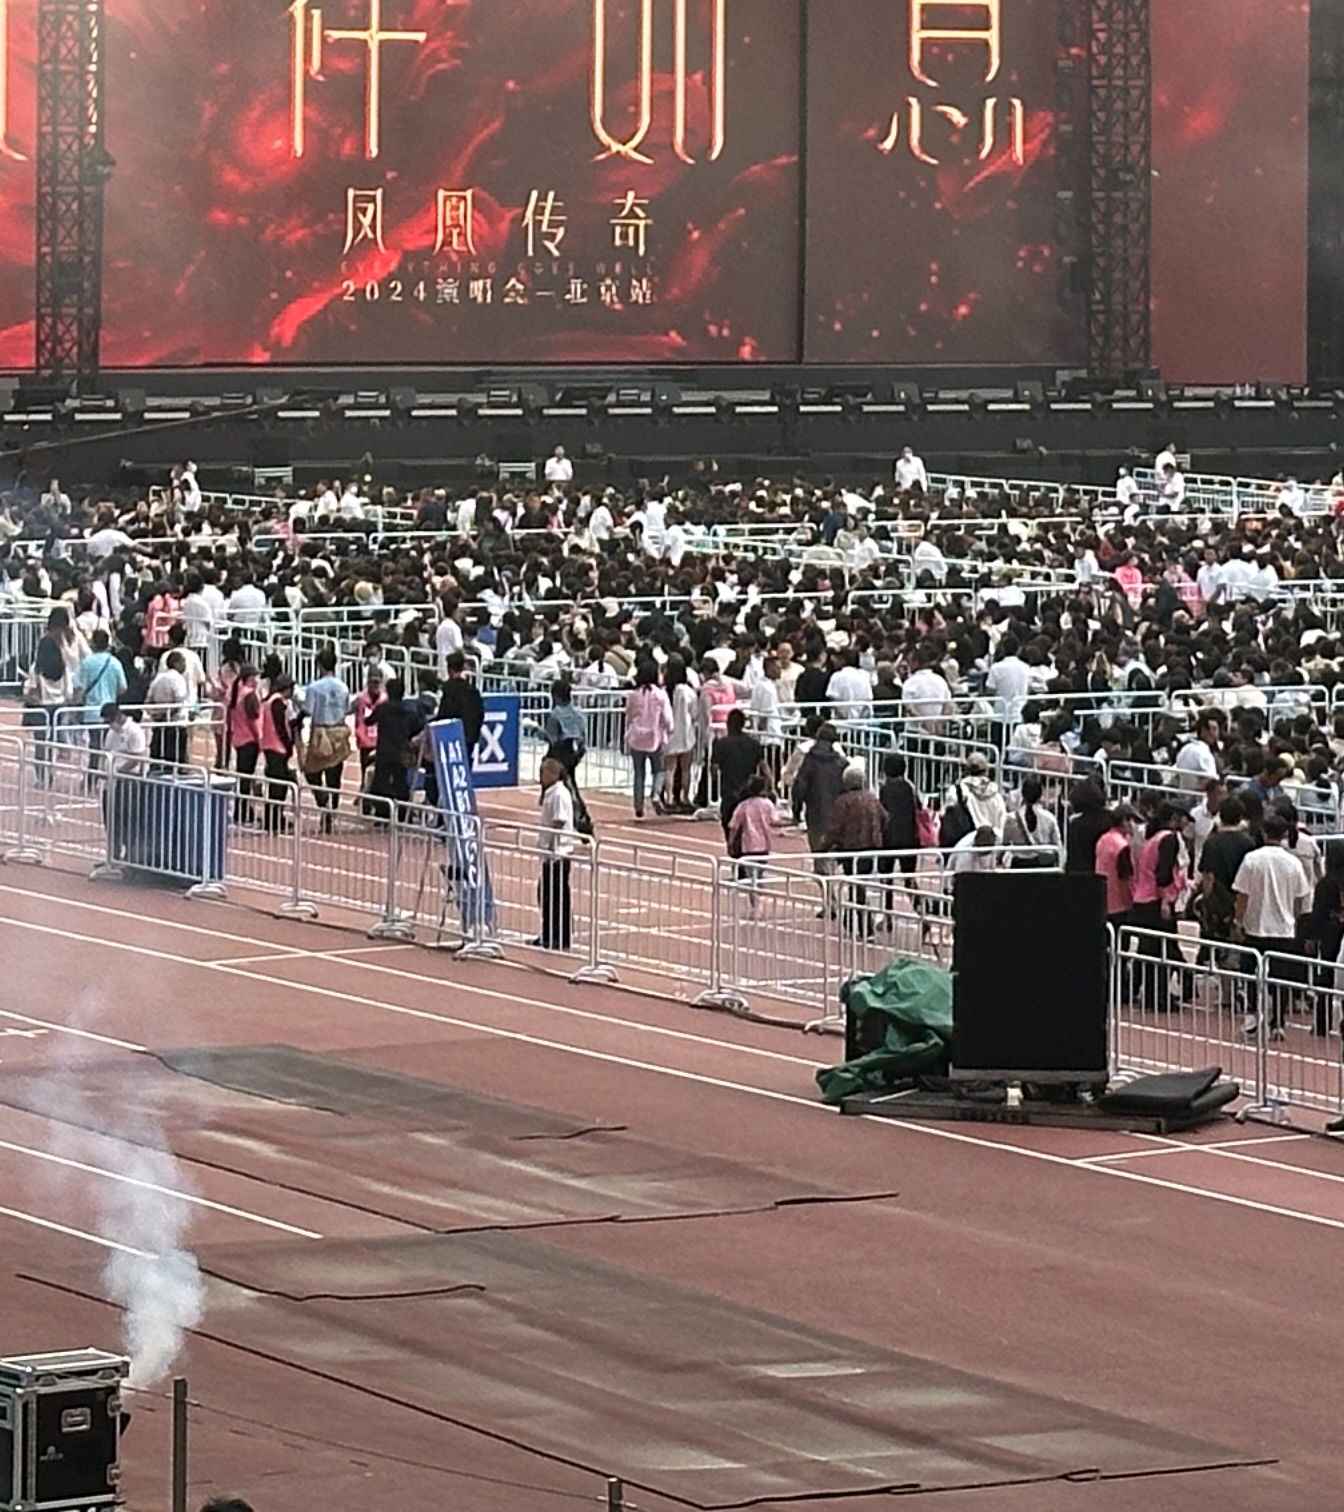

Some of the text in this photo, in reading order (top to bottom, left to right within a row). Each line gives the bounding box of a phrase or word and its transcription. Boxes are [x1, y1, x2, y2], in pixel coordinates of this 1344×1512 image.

[343, 187, 654, 257] 凤凰传奇
[448, 739, 463, 763] A1
[452, 765, 468, 788] A2
